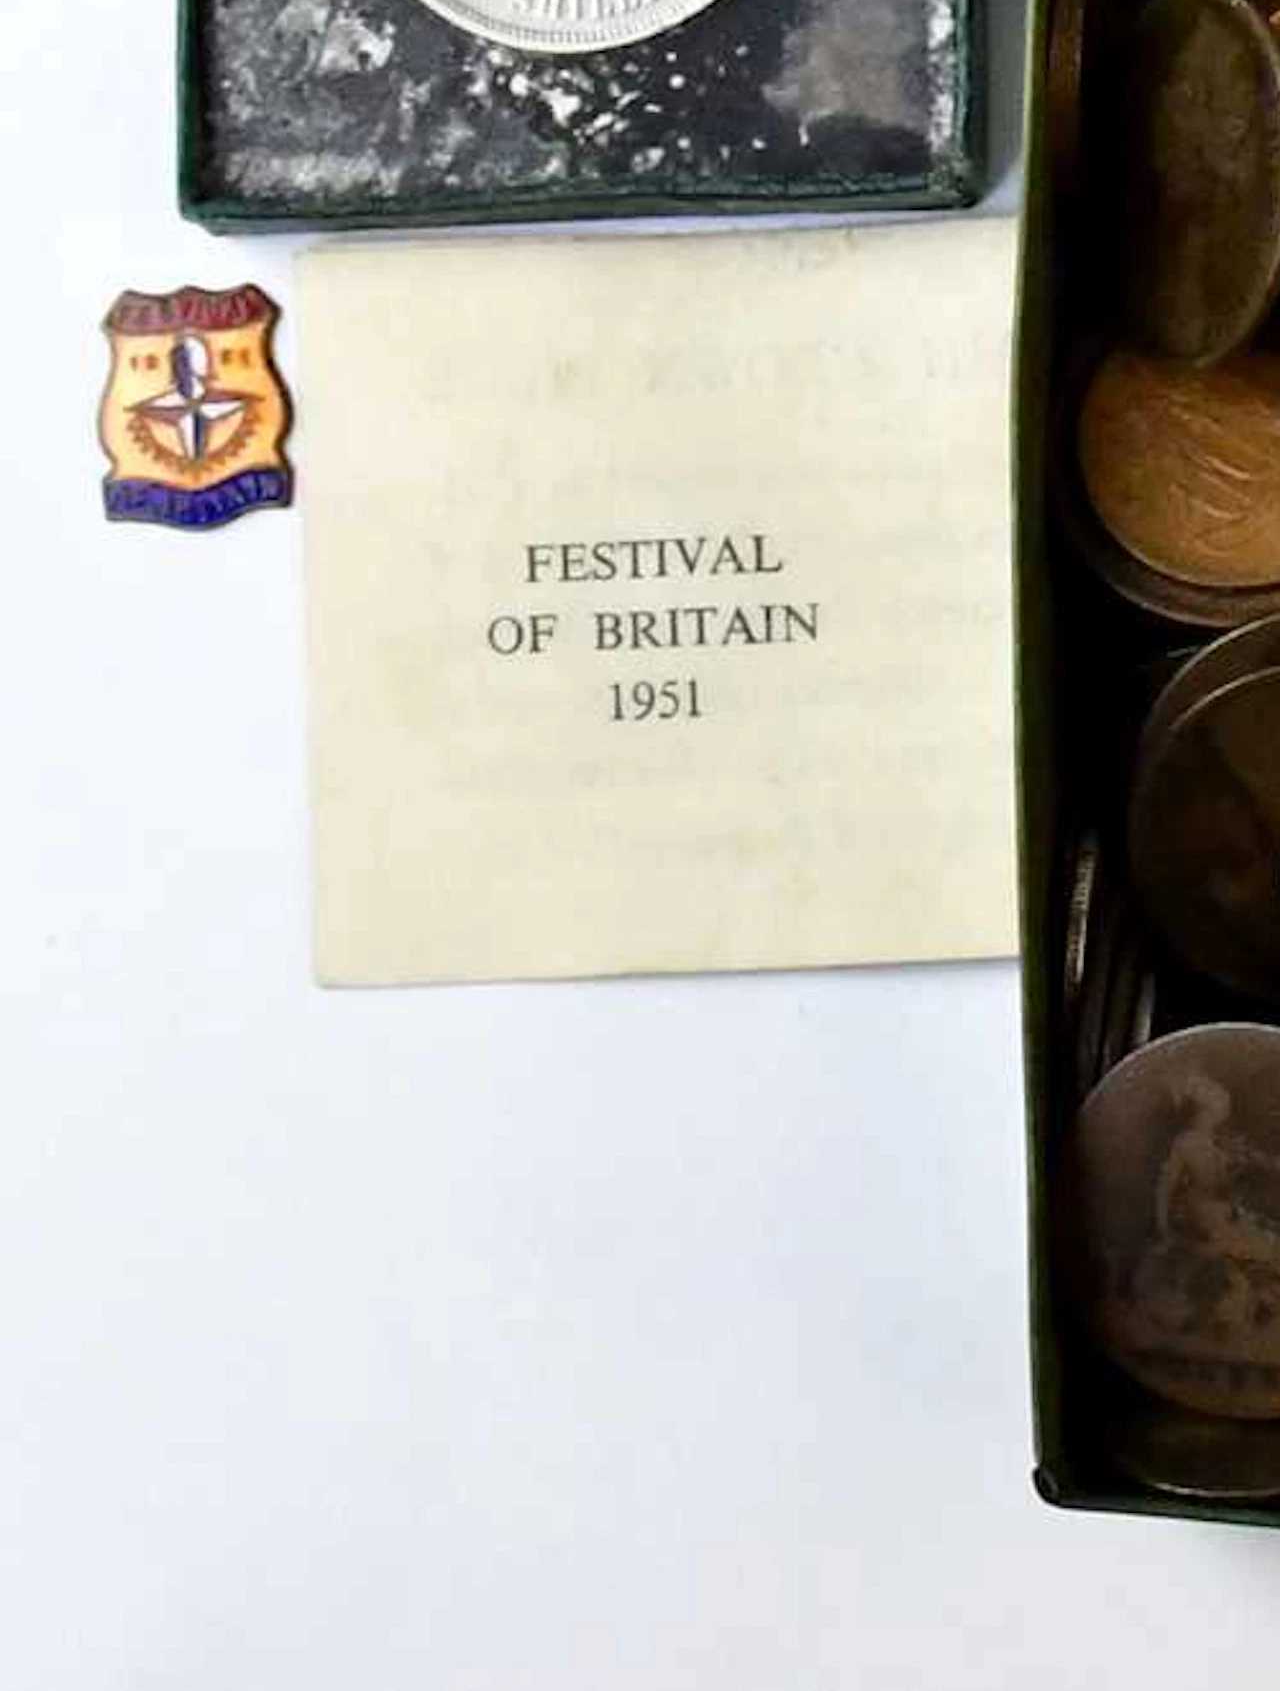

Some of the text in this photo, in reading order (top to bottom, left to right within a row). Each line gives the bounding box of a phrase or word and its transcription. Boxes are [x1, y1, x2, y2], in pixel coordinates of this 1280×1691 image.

[525, 534, 784, 584] FESTIVAL
[487, 602, 821, 656] OF BRITAIN
[609, 677, 705, 723] 1951
